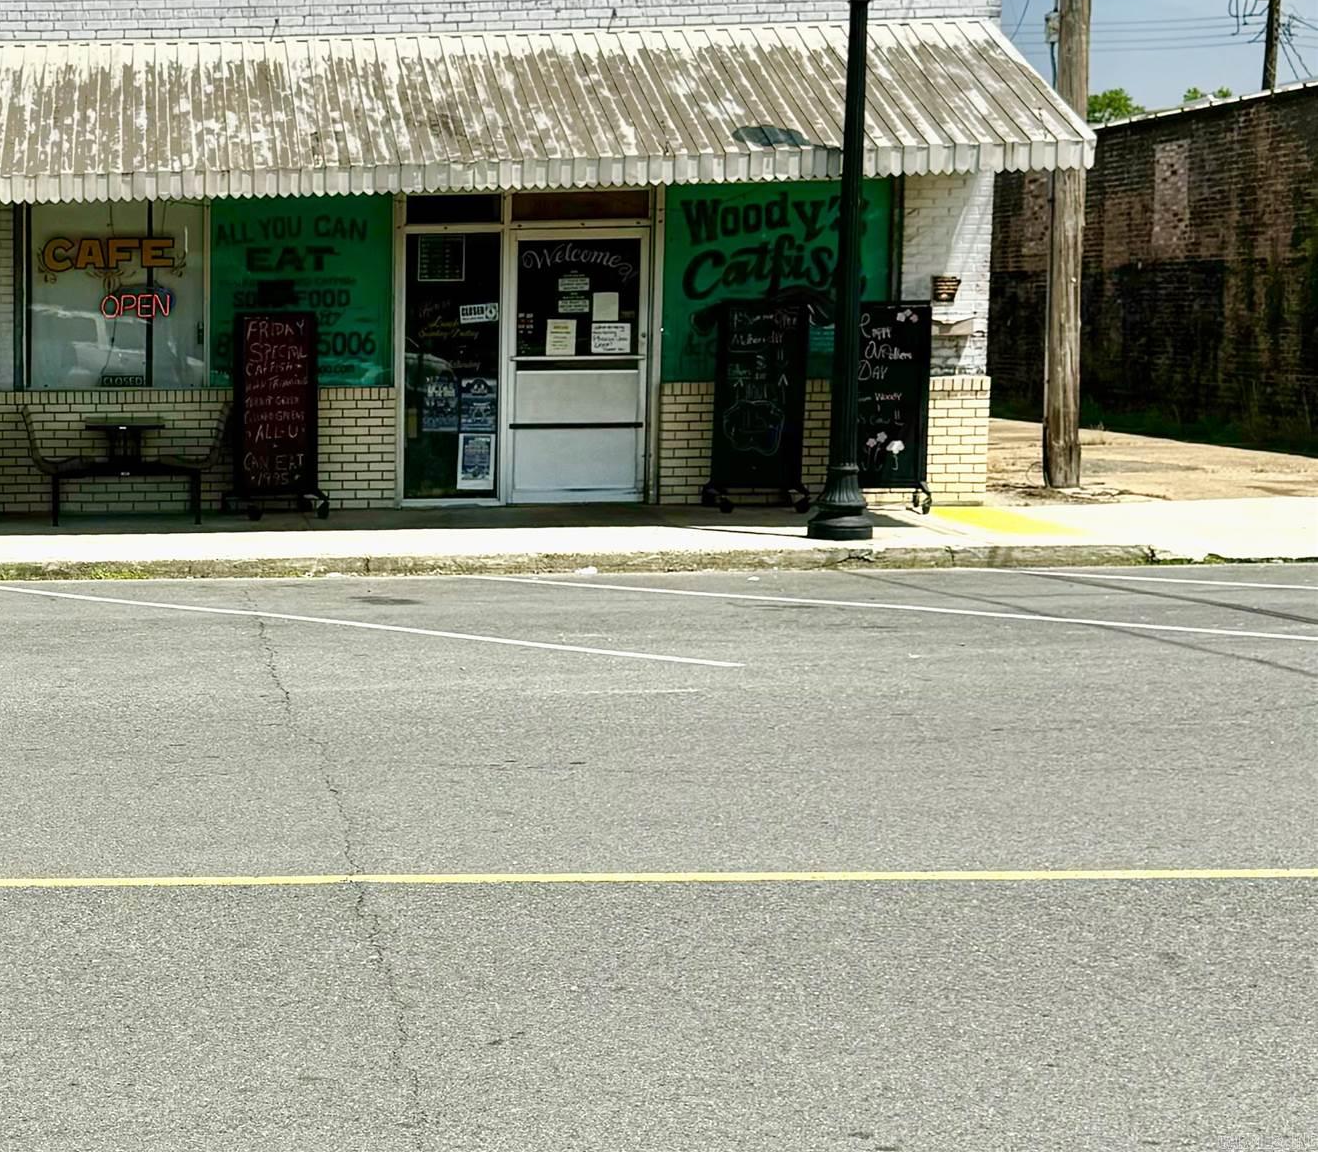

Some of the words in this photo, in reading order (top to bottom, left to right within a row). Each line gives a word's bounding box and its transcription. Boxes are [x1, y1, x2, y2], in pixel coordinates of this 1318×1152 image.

[216, 221, 255, 246] ALL
[258, 215, 302, 241] YOU
[314, 214, 368, 243] CAN
[42, 237, 175, 272] CAFE
[245, 245, 340, 272] EAT
[522, 242, 636, 279] Welcome
[682, 234, 866, 301] Catfis
[100, 293, 171, 319] OPEN
[294, 288, 351, 308] FOOD
[246, 320, 305, 341] FRIDAY
[102, 376, 143, 386] CLOSED
[243, 451, 270, 471] CAN
[275, 452, 305, 471] EAT
